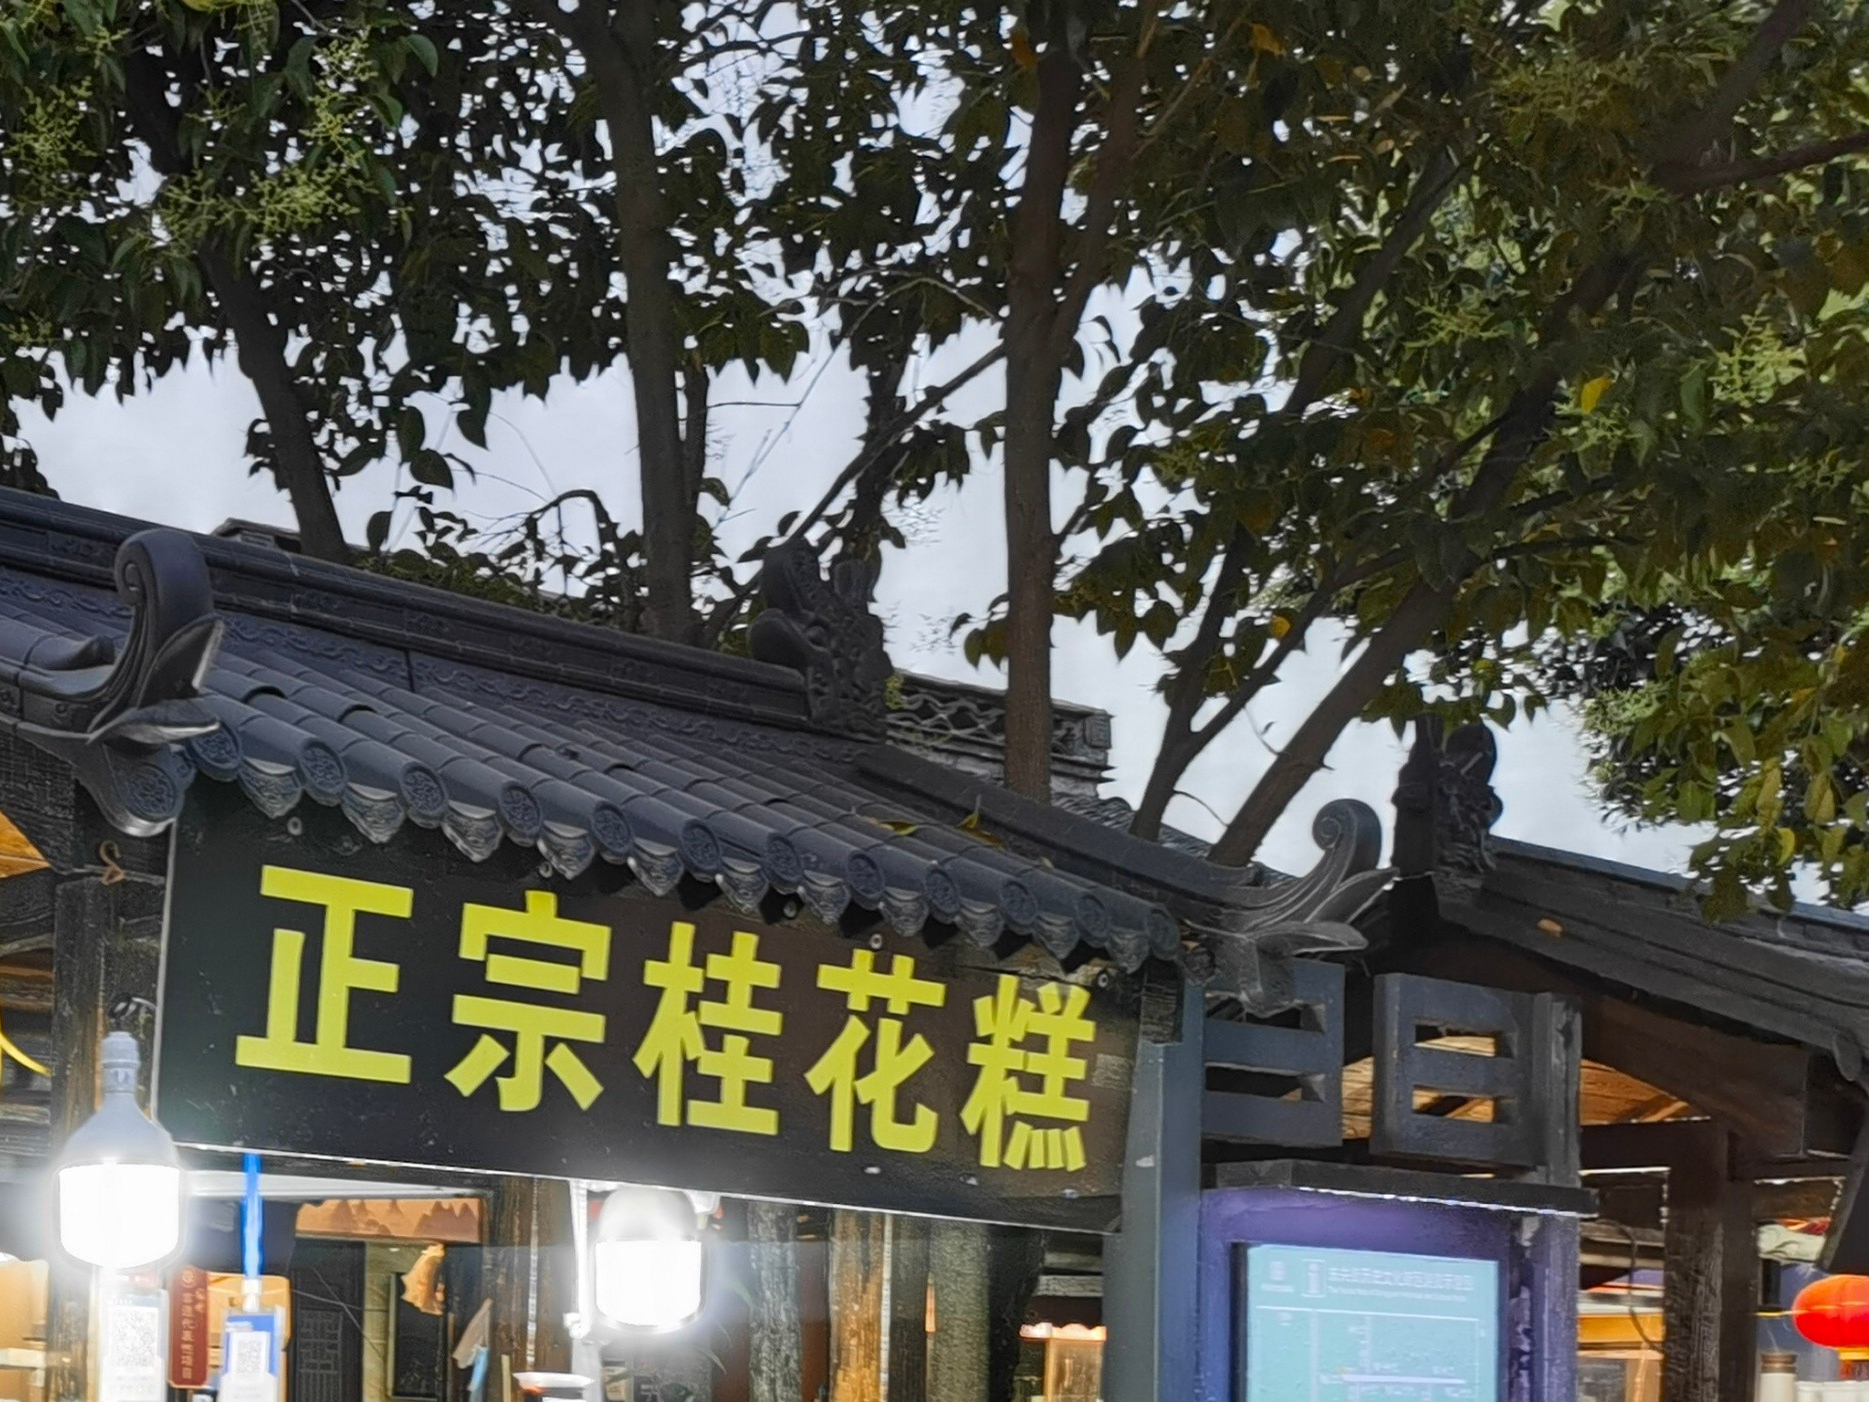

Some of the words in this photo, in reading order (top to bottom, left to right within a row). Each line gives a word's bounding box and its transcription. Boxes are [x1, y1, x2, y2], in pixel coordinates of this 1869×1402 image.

[236, 865, 1094, 1171] 正宗桂花糕
